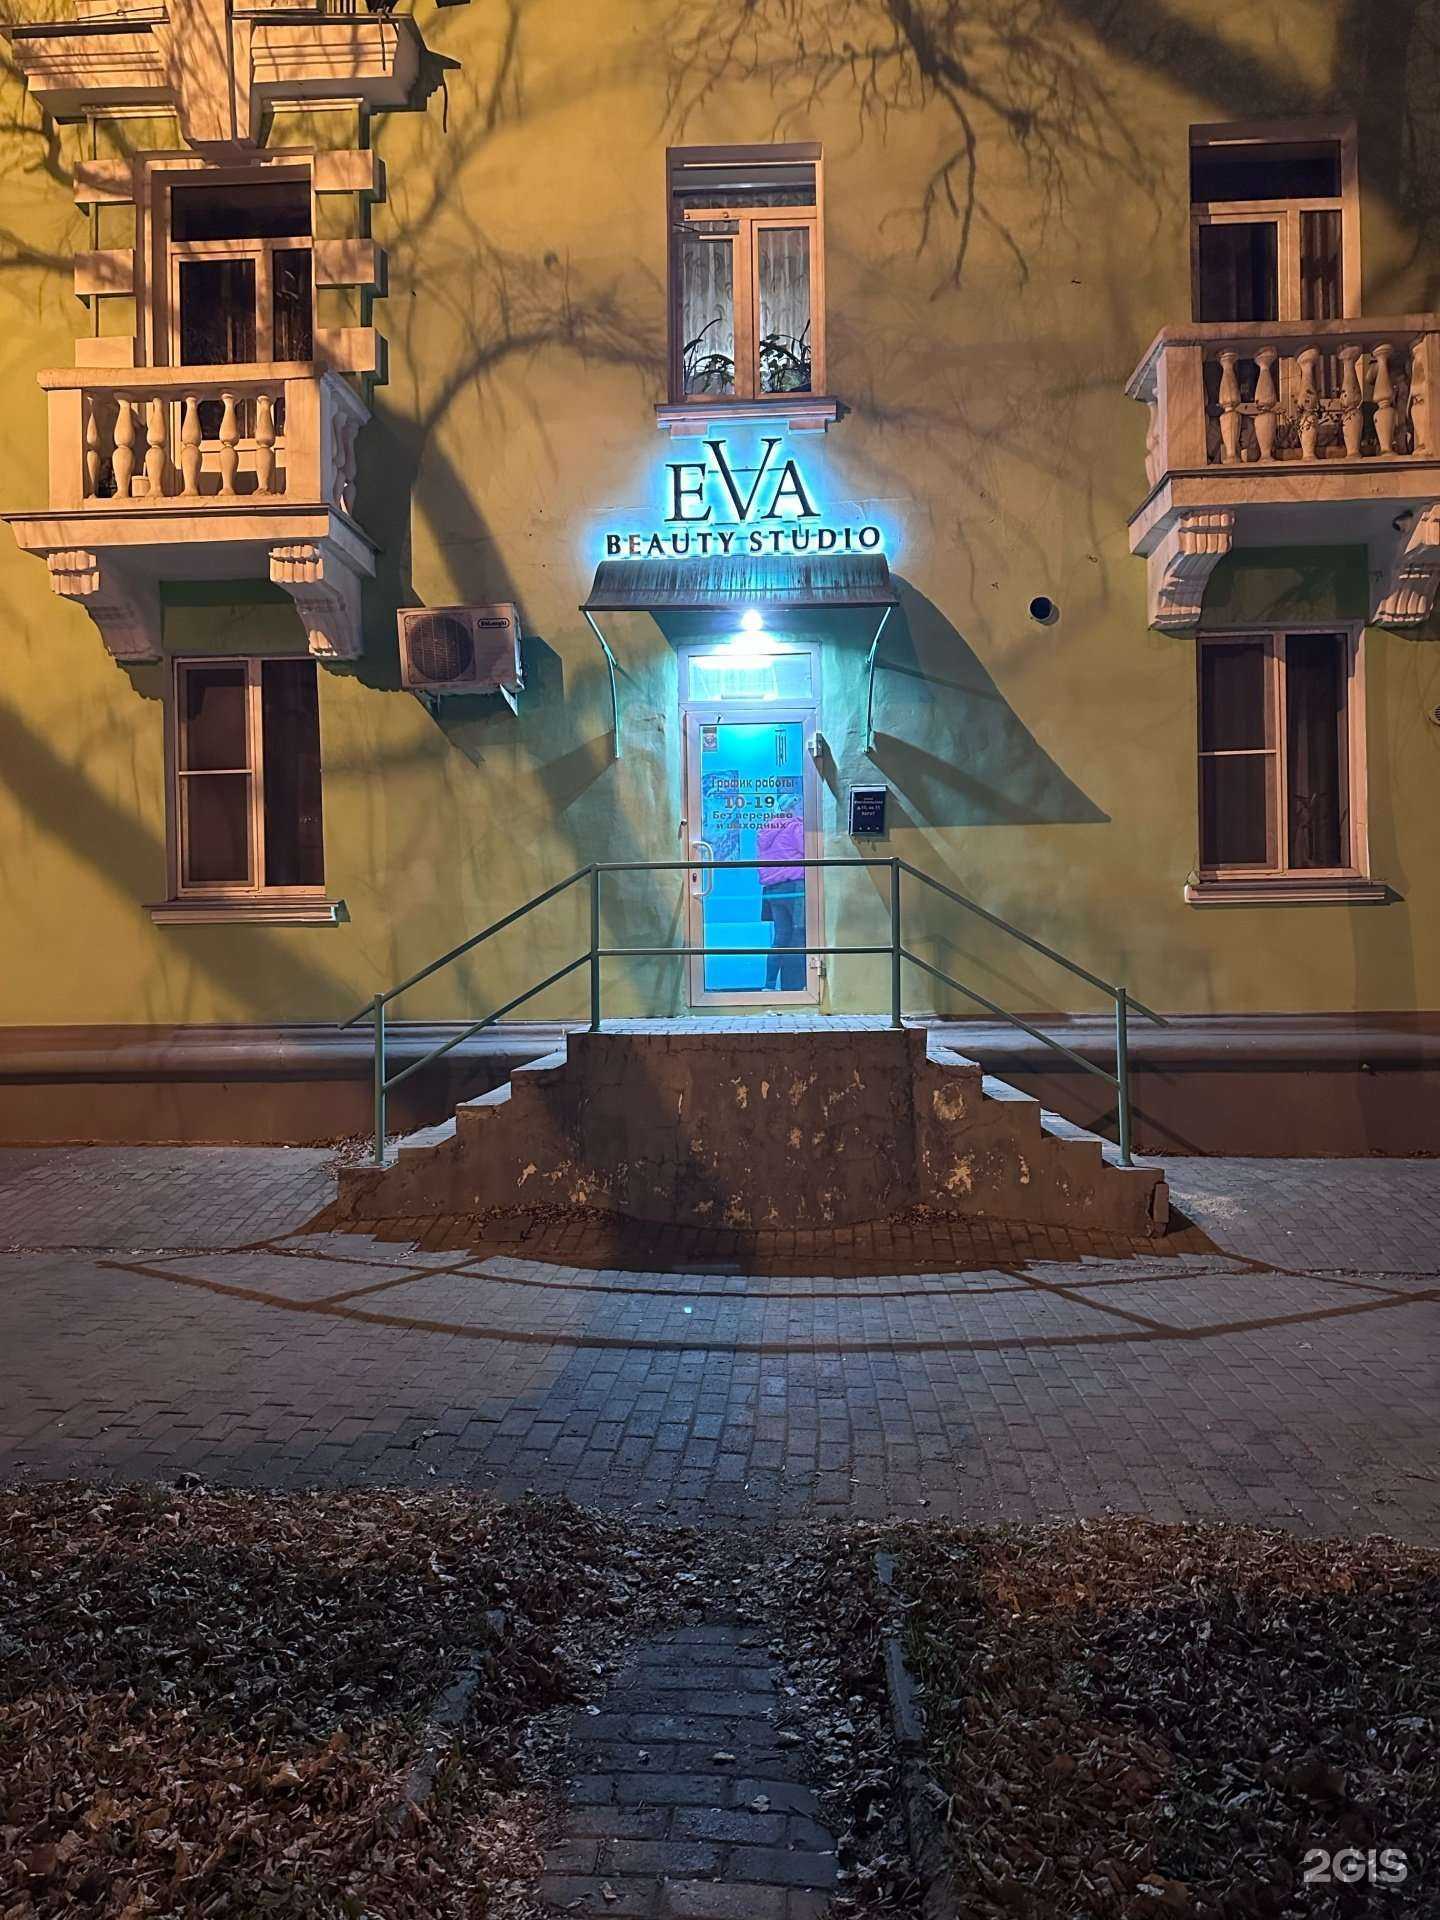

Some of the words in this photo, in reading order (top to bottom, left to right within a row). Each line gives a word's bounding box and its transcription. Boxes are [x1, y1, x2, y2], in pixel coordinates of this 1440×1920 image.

[664, 437, 821, 523] EVA
[606, 531, 739, 556] BEAUTY
[750, 527, 881, 554] STUDIO
[712, 776, 752, 792] График
[755, 776, 794, 792] работы
[724, 796, 775, 809] 10-19
[736, 812, 793, 821] перерыва
